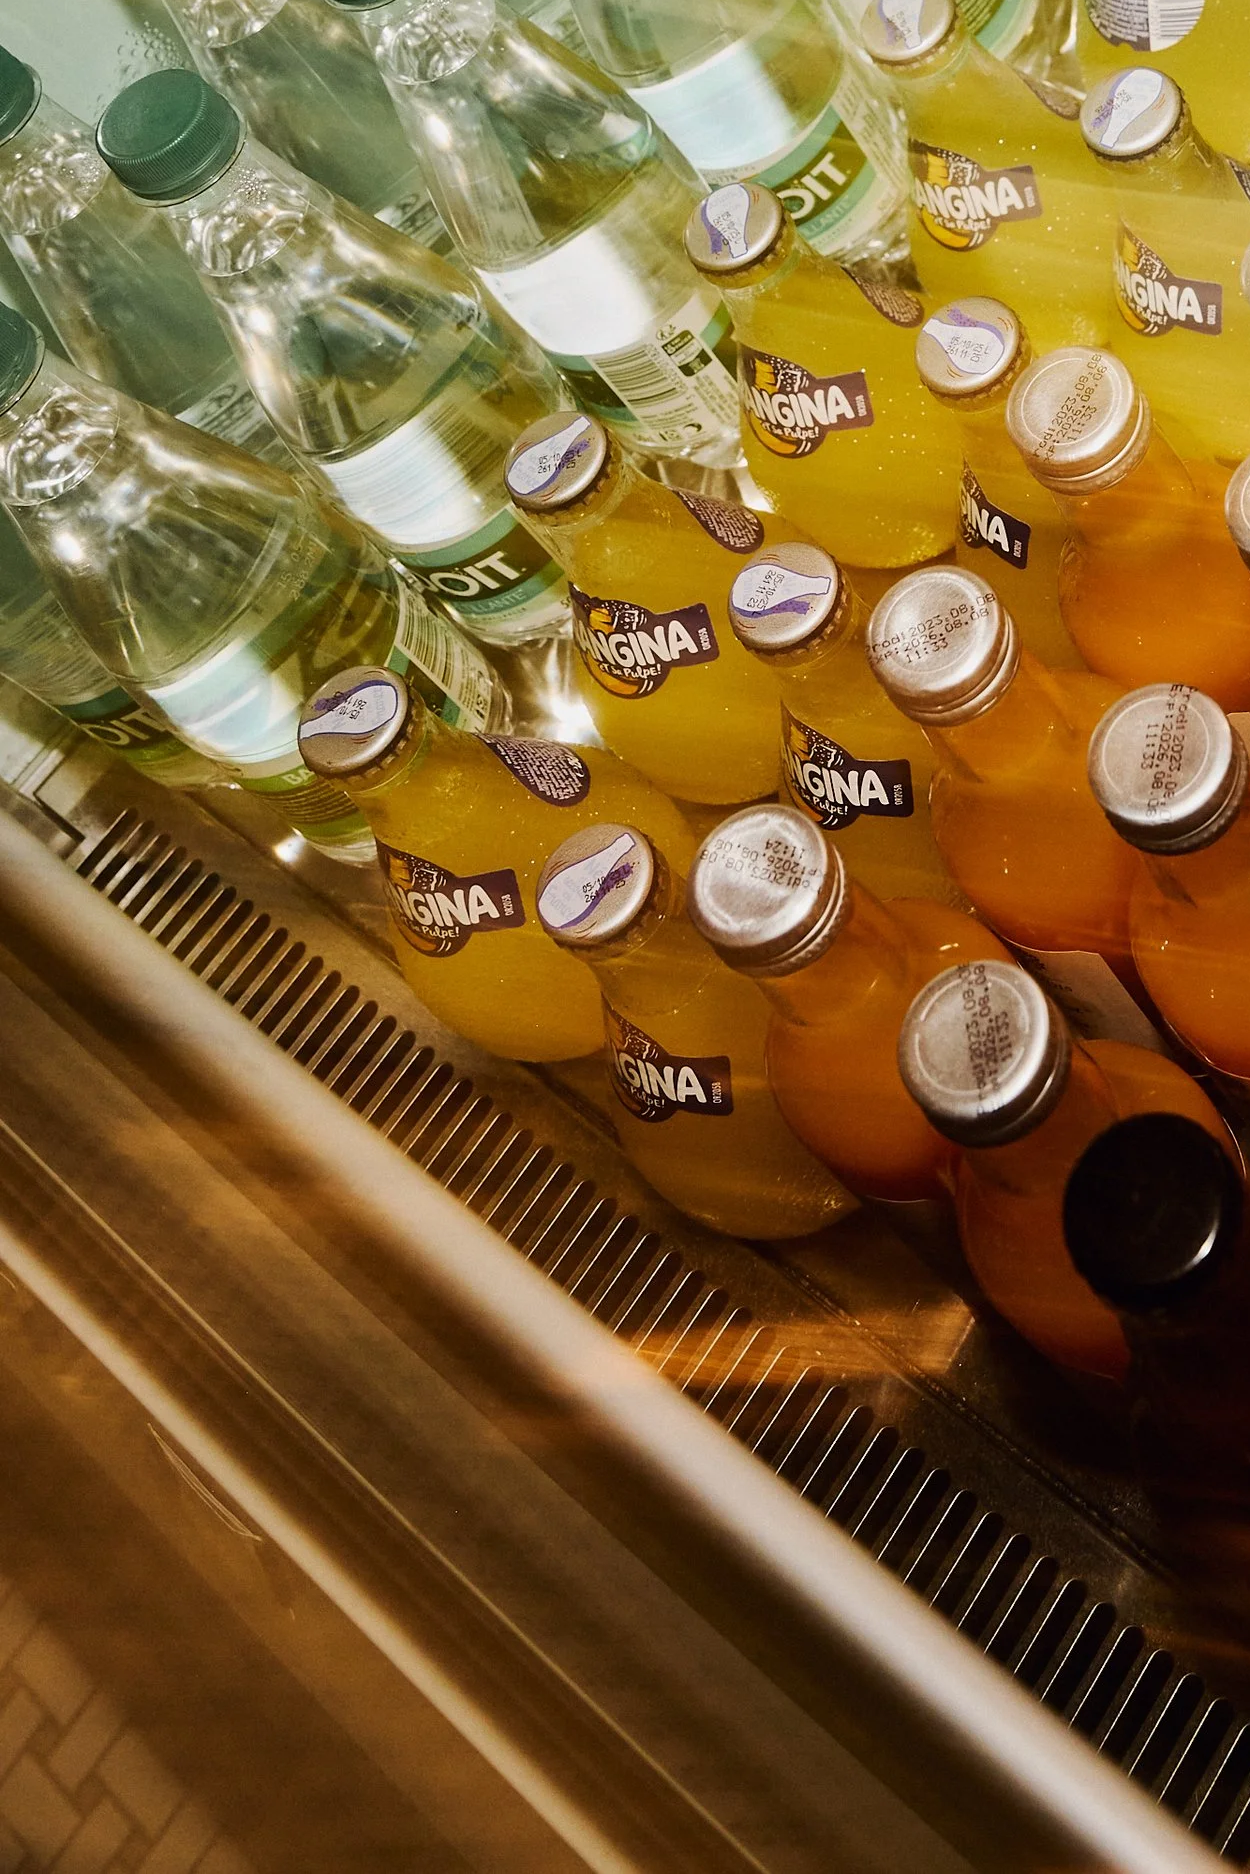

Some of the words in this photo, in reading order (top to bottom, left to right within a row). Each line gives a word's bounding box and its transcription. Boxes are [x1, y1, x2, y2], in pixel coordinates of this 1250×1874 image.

[775, 151, 848, 221] OIT
[914, 176, 1025, 221] ANGINA
[1113, 263, 1204, 324] NGINA
[742, 384, 856, 428] ANGINA
[1067, 405, 1098, 442] 11:33
[575, 620, 699, 668] ANGINA
[904, 636, 949, 664] 11:33
[1140, 723, 1159, 770] 11:33
[784, 746, 890, 807] NGINA
[765, 838, 806, 860] 11:24
[385, 878, 500, 928] NGINA
[616, 1050, 708, 1104] GINA
